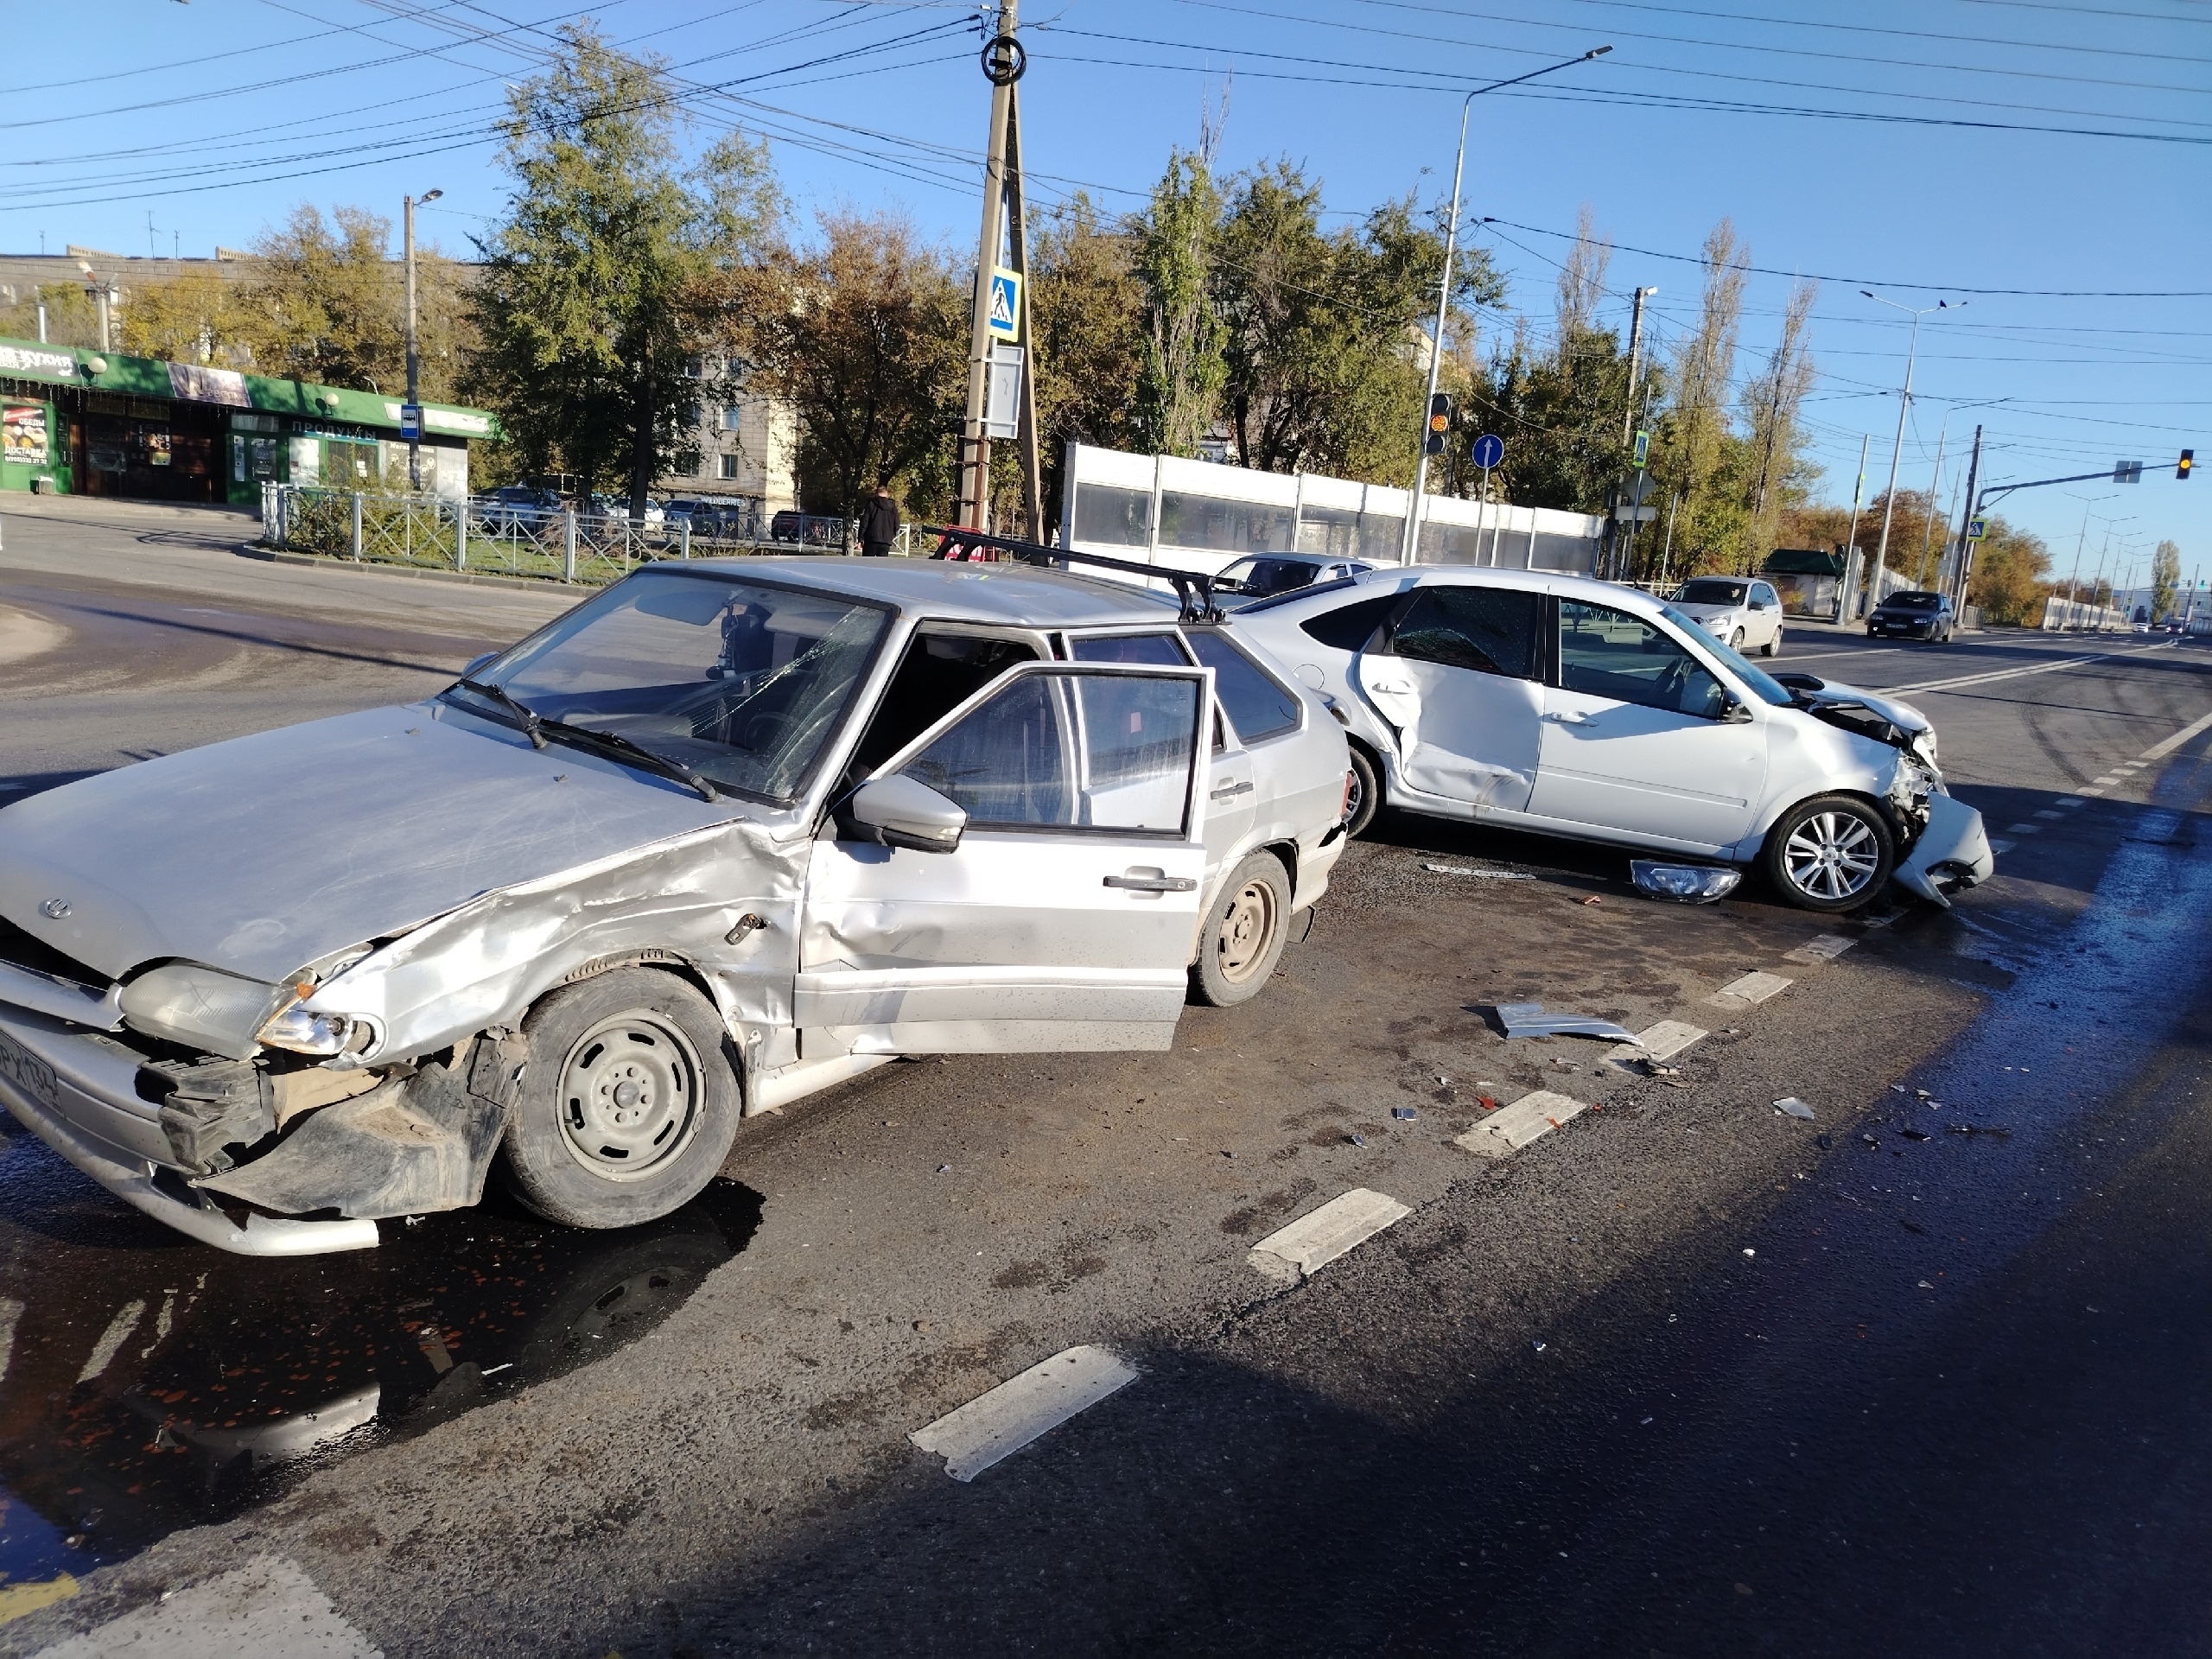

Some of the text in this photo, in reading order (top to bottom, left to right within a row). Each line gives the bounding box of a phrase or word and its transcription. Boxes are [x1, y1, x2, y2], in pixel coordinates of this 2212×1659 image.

[18, 418, 45, 427] ОБЕДЫ
[292, 421, 377, 441] ПРОДУКТЫ
[4, 445, 48, 459] ДОСТАВКА
[701, 496, 746, 507] WILDBERRIES
